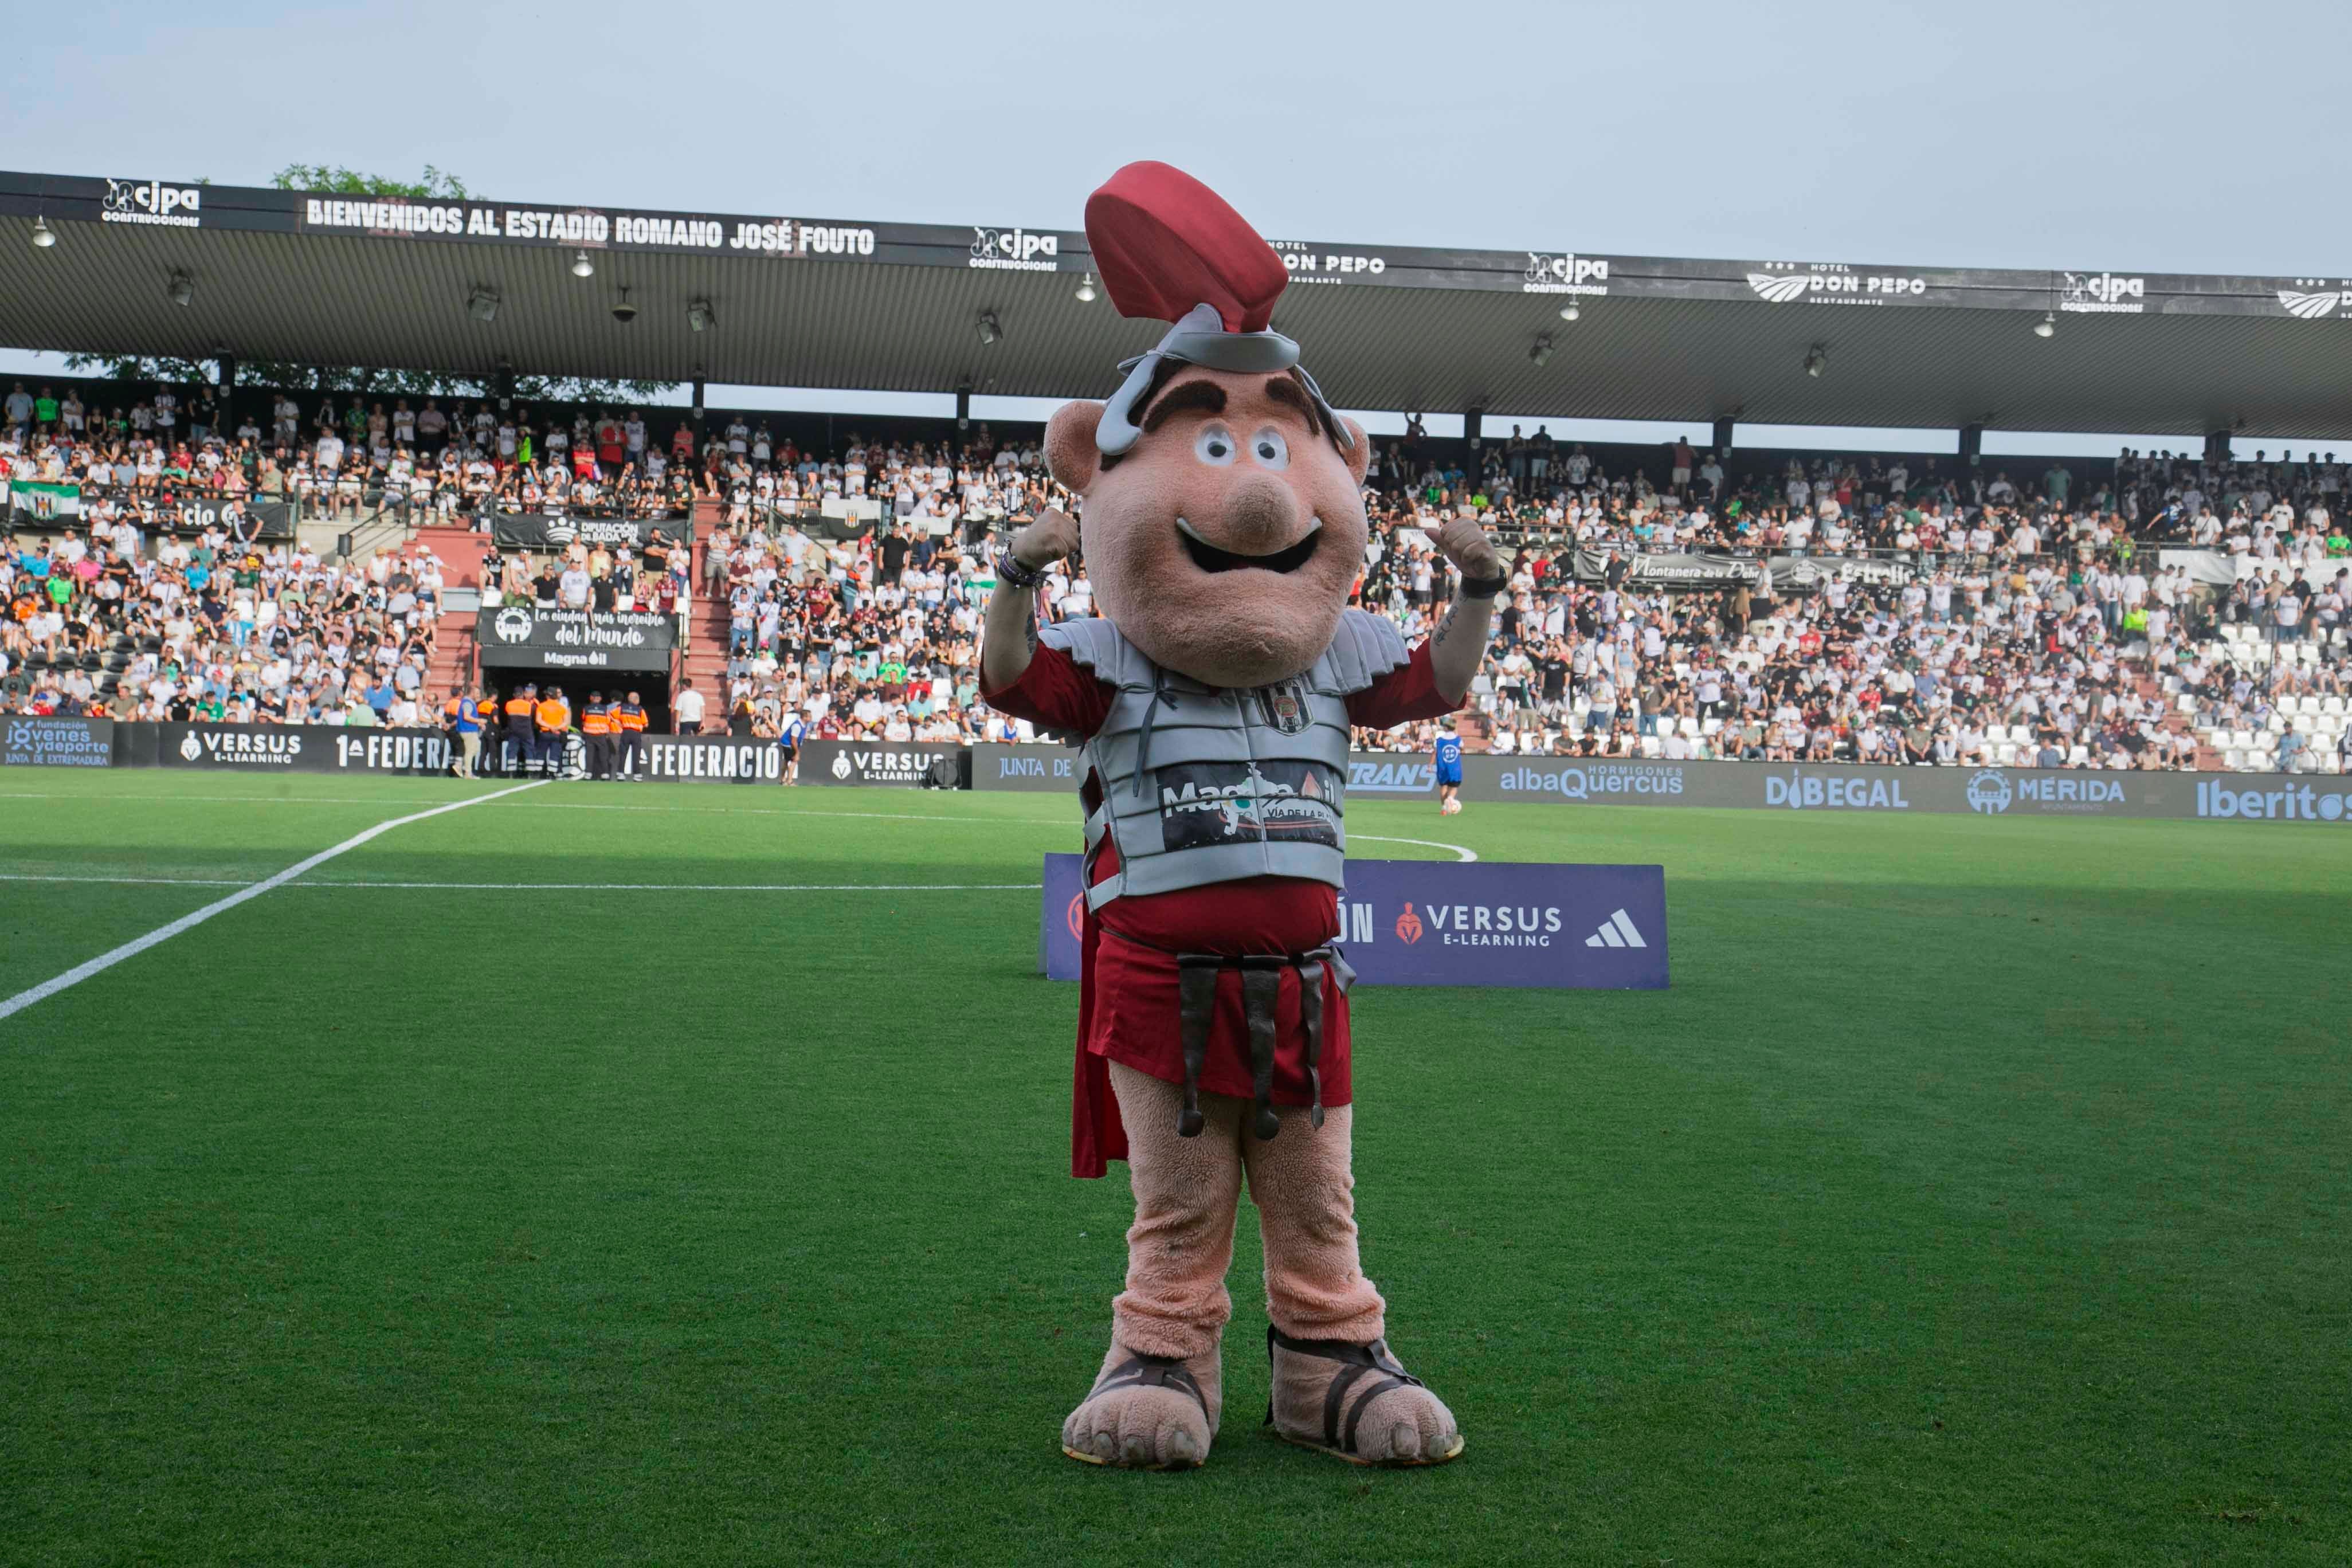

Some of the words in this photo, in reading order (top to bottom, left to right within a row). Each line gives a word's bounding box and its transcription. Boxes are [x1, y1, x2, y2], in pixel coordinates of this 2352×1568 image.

[135, 180, 200, 213] cjpa
[101, 211, 200, 228] CONSTRUCCIONES
[307, 199, 463, 234] BIENVENIDOS
[467, 209, 500, 236] AL
[505, 211, 609, 242] ESTADIO
[616, 216, 723, 249] ROMANO
[730, 219, 792, 251] JOSÉ
[799, 226, 875, 256] FOUTO
[999, 228, 1058, 260] cjpa
[969, 258, 1058, 272] CONSTRUCCIONES
[1283, 253, 1316, 271] ON
[1326, 256, 1386, 274] PEPO
[1552, 253, 1608, 284] cjpa
[1810, 264, 1851, 273] HOTEL
[1809, 275, 1859, 292] DON
[1867, 277, 1926, 295] PEPO
[2088, 272, 2145, 303] cjpa
[1809, 297, 1883, 305] RESTAURANTE
[581, 520, 638, 533] DIPUTACIÓN
[1632, 555, 1701, 577] Montanera
[535, 608, 550, 621] La
[555, 624, 582, 646] del
[585, 625, 645, 648] Mundo
[37, 720, 87, 730] fundación
[203, 732, 301, 754] VERSUS
[6, 752, 29, 765] JUNTA
[33, 754, 44, 764] DE
[47, 753, 108, 766] EXTREMADURA
[214, 752, 292, 764] E-LEARNING
[651, 742, 798, 779] FEDERACIÓ
[999, 758, 1045, 779] JUNTA
[1053, 758, 1072, 777] DE
[1588, 765, 1683, 777] HORMIGONES
[1500, 767, 1683, 799] albaQuercus
[2018, 777, 2126, 802] MÉRIDA
[1426, 905, 1562, 932] VERSUS
[1444, 932, 1550, 947] E-LEARNING
